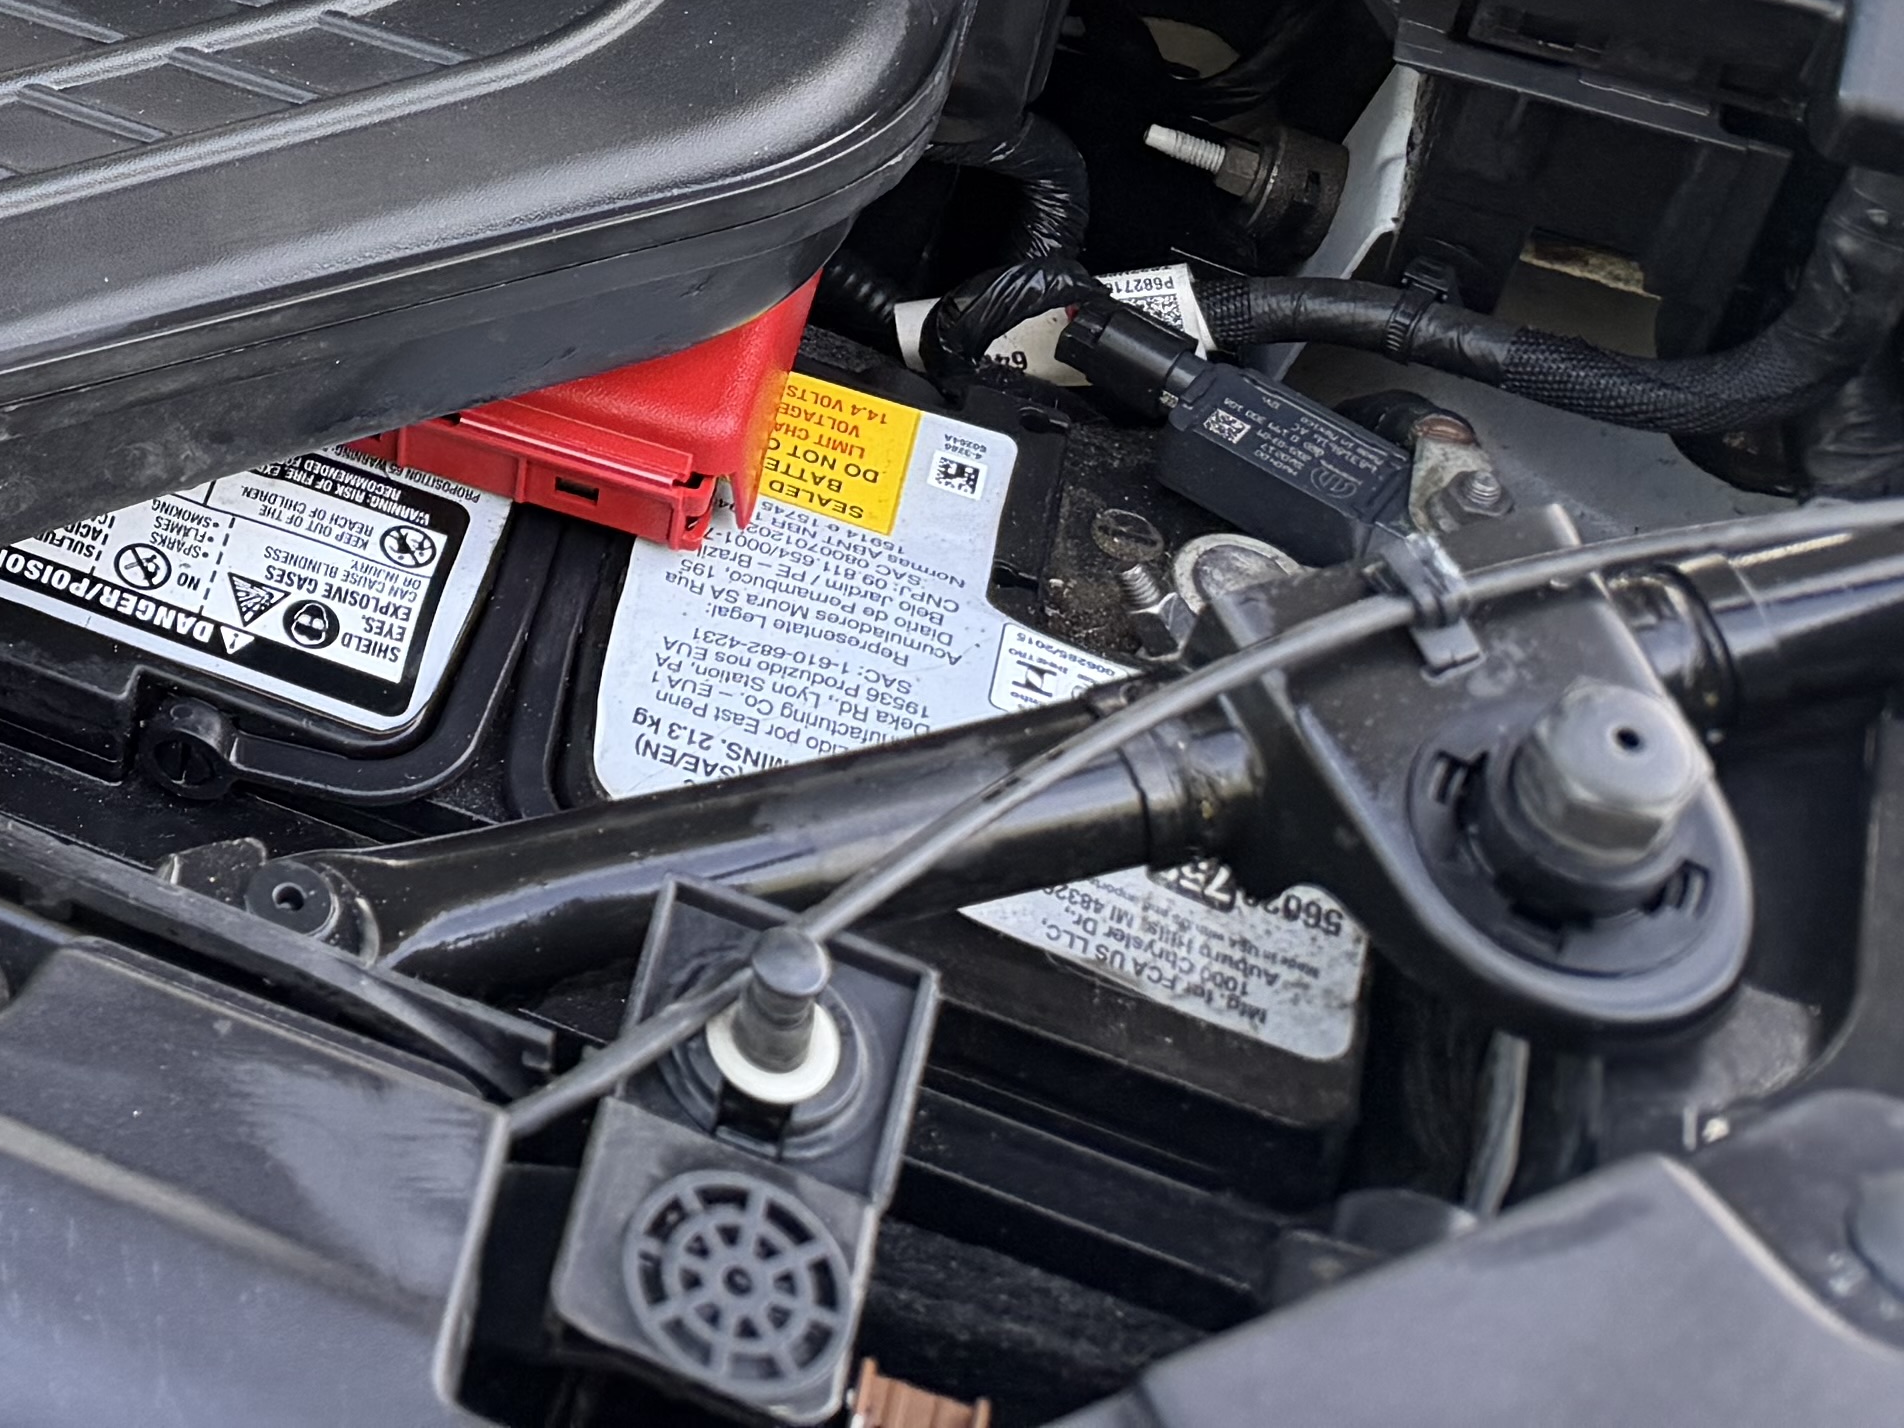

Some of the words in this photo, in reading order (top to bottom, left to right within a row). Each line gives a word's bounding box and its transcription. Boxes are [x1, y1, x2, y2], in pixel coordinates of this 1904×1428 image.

[784, 383, 845, 413] VOLTS
[847, 402, 890, 425] 14.4
[772, 419, 811, 442] CHA
[812, 431, 866, 459] LIMIT
[785, 442, 837, 471] NOT
[301, 457, 403, 501] RECOMMENDED
[312, 475, 333, 494] OF
[762, 455, 843, 493] BATTE
[841, 461, 880, 484] DO
[332, 481, 367, 504] RISK
[766, 477, 865, 520] SEALED
[148, 496, 213, 529] SMOKING
[256, 501, 284, 522] THE
[283, 510, 304, 529] OF
[306, 504, 327, 523] OF
[326, 511, 374, 538] REACH
[32, 525, 96, 559] SULFU
[152, 514, 208, 543] FLAMES
[302, 517, 334, 539] OUT
[332, 527, 370, 552] KEEP
[768, 515, 818, 540] NBR
[147, 529, 202, 559] SPARKS
[695, 540, 753, 570] Brazil
[701, 524, 889, 590] 09.811.654/0001-7
[742, 520, 871, 570] 0800701202
[820, 532, 883, 560] ABNT
[261, 543, 339, 579] BLINDNESS
[678, 556, 717, 580] 195
[774, 562, 807, 583] PE
[873, 562, 922, 586] SAC
[885, 551, 966, 588] Normas
[174, 570, 201, 591] NO
[262, 562, 320, 595] GASES
[339, 568, 386, 594] CAUSE
[401, 574, 422, 590] OR
[661, 569, 706, 595] Rua
[707, 582, 741, 604] SA
[822, 575, 895, 610] Jardim
[319, 580, 413, 623] EXPLOSIVE
[386, 583, 418, 604] CAN
[744, 589, 810, 621] Moura
[889, 580, 961, 614] CNPJ:
[702, 596, 767, 631] Legal:
[859, 604, 890, 626] de
[895, 598, 946, 626] Belo
[338, 630, 402, 664] SHIELD
[658, 633, 709, 662] EUA
[690, 624, 853, 677] 1-610-682-4231
[812, 607, 963, 666] Acumuladores
[651, 651, 683, 673] PA
[711, 648, 752, 671] nos
[664, 672, 714, 698] EUA
[686, 658, 767, 696] Station,
[753, 655, 861, 699] Produzido
[853, 663, 914, 695] SAC:
[651, 687, 709, 718] Penn
[735, 690, 775, 717] Co.
[768, 677, 823, 709] Lyon
[862, 685, 933, 720] 19536
[628, 705, 663, 735] kg
[709, 704, 761, 735] East
[765, 719, 802, 744] por
[776, 700, 897, 752] nufacturing
[872, 707, 931, 738] Deka
[663, 720, 715, 752] 21.3
[1106, 903, 1136, 928] MI
[1035, 916, 1093, 954] LLC,
[1102, 921, 1197, 977] Chrysler
[1090, 940, 1128, 969] US
[1126, 955, 1179, 990] FCA
